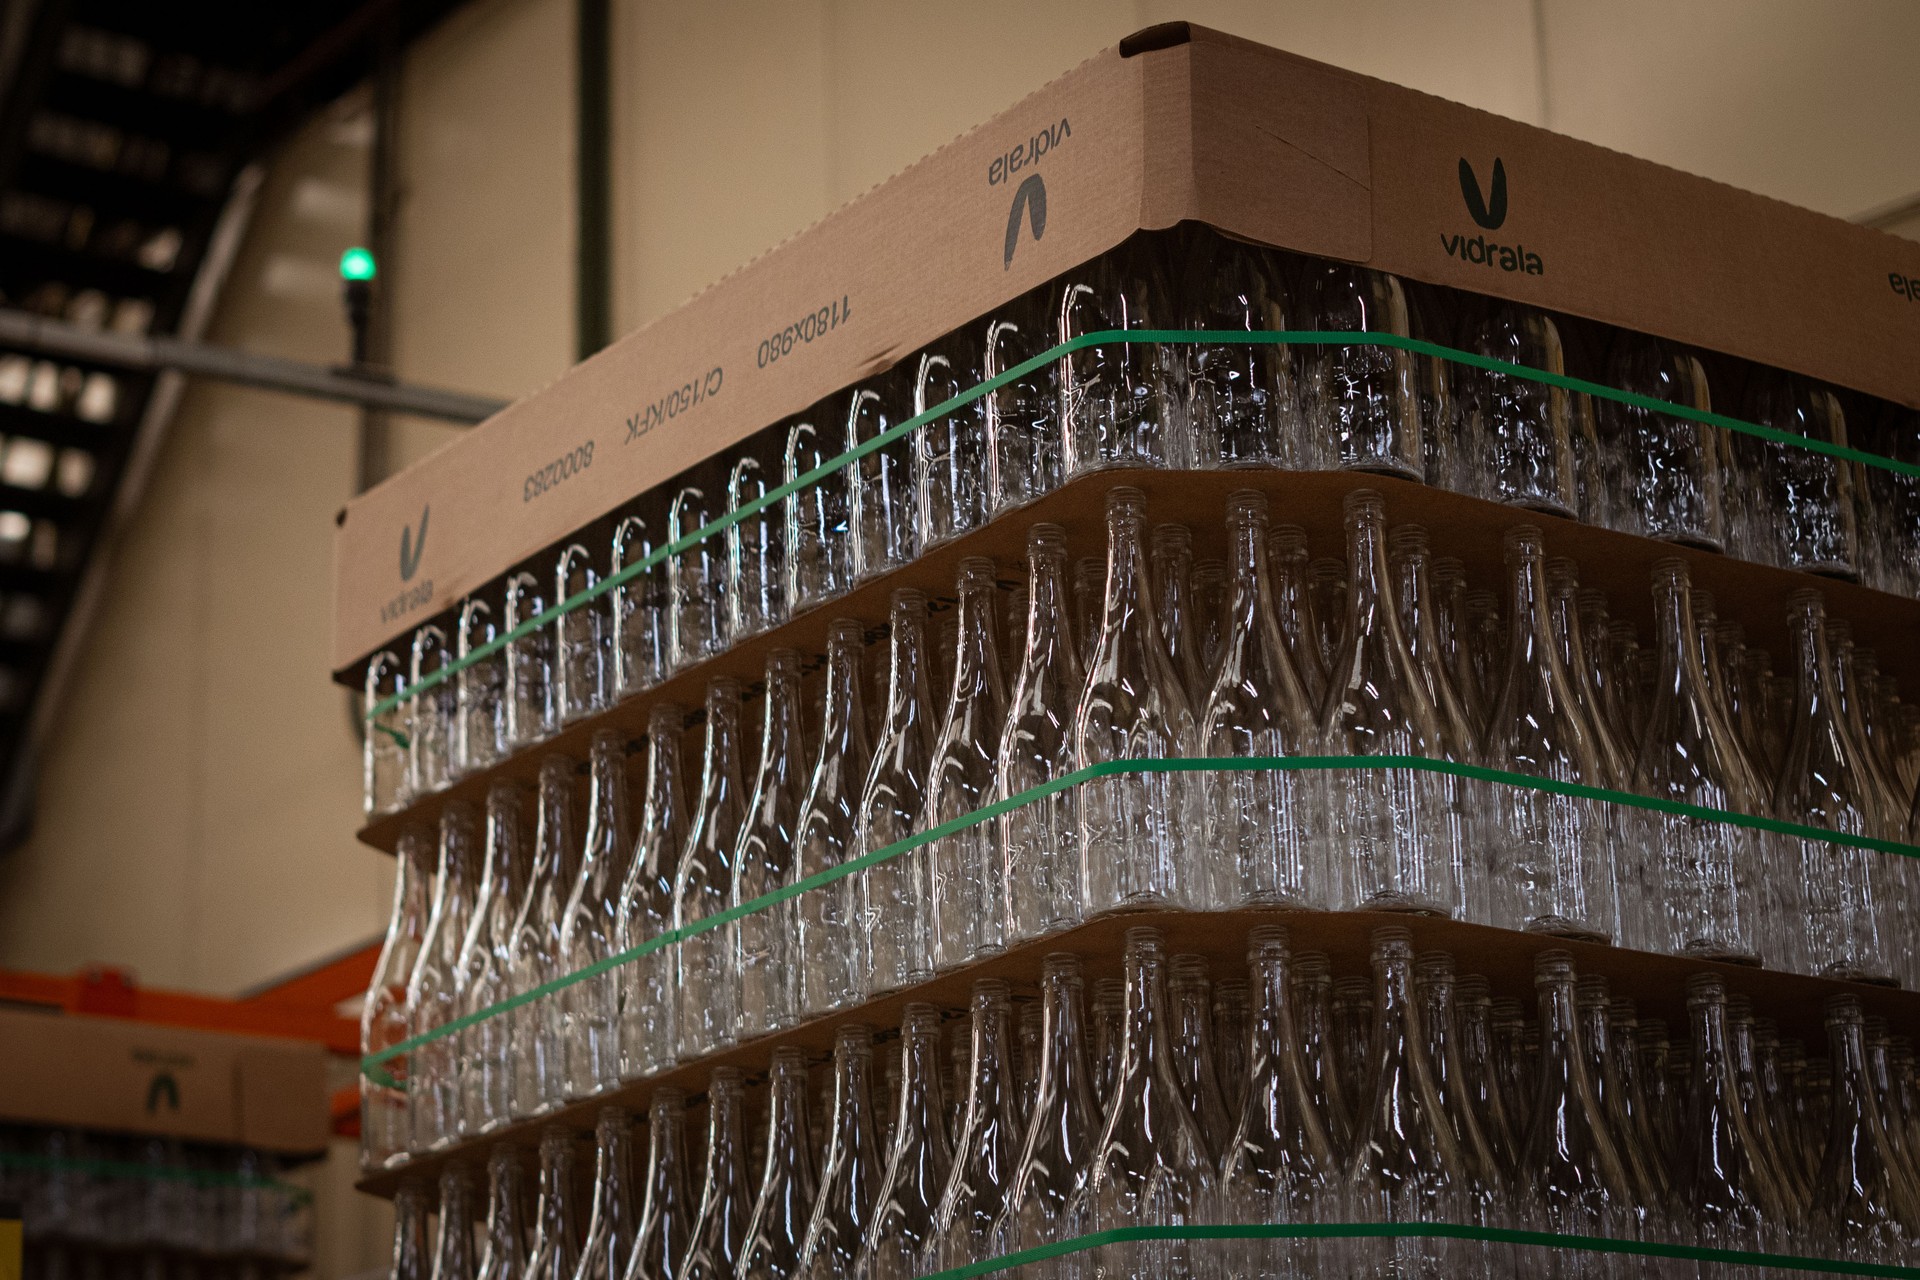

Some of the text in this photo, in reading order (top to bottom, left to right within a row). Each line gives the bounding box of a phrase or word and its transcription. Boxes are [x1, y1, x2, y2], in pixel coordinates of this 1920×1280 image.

[988, 117, 1071, 186] vidrala
[1440, 233, 1544, 276] vidrala
[757, 295, 851, 369] 1180x980
[625, 367, 723, 445] C/150/KFK
[523, 440, 595, 503] 8000283
